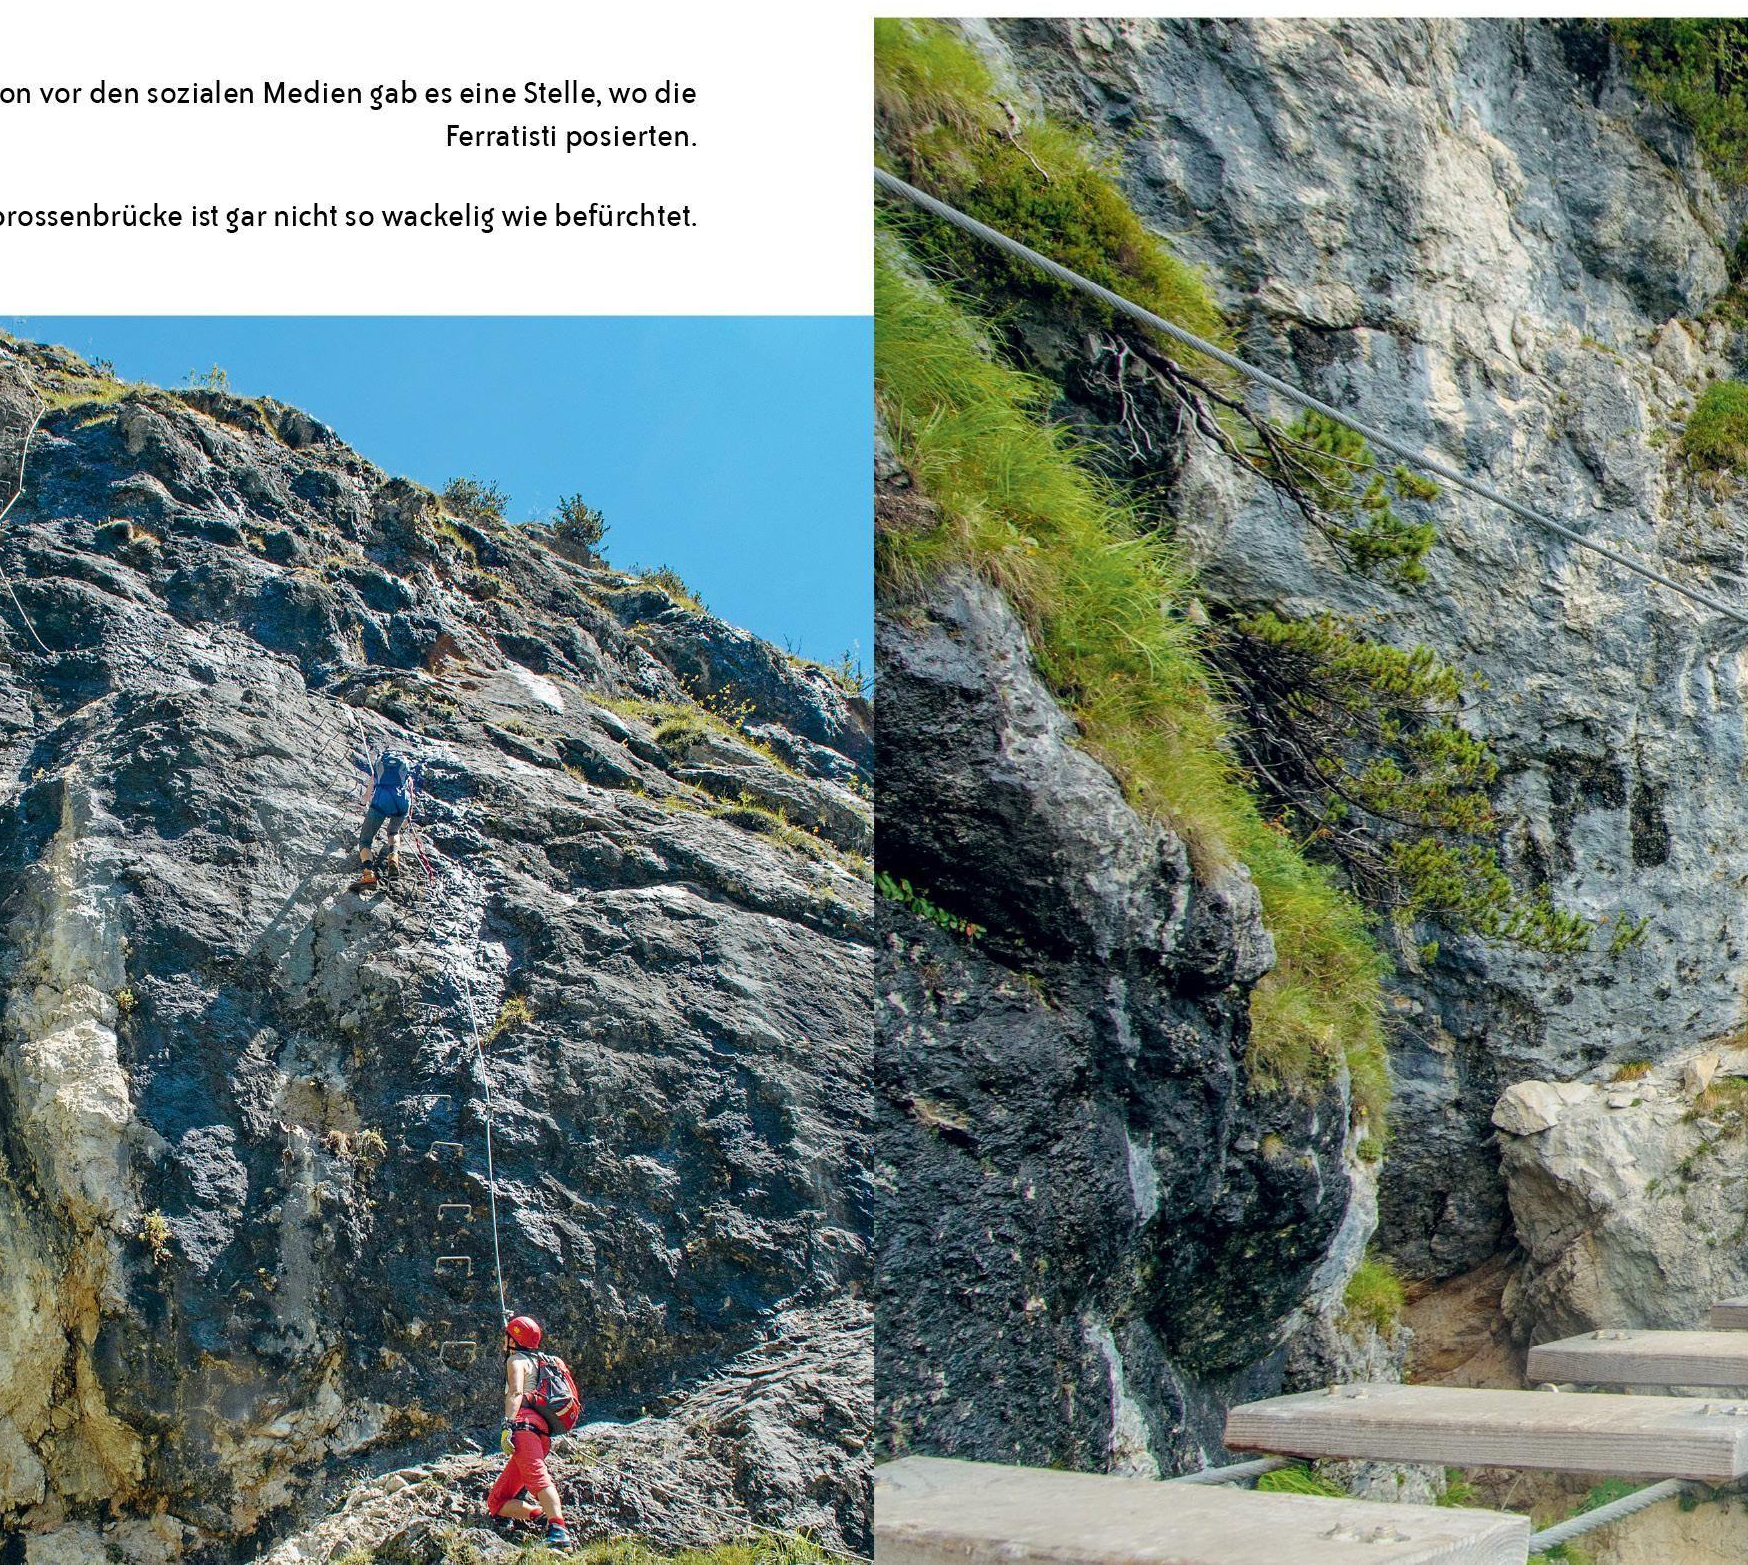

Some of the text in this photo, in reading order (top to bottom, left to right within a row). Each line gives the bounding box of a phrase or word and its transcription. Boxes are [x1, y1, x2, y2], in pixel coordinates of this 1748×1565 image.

[40, 88, 82, 103] vor
[90, 80, 138, 103] den
[148, 80, 253, 103] sozialen
[265, 80, 361, 103] Medien
[370, 80, 416, 110] gab
[426, 88, 451, 103] es
[460, 83, 516, 103] eine
[524, 80, 601, 107] Stelle,
[609, 88, 647, 103] wo
[656, 80, 696, 103] die
[448, 125, 696, 153] Ferratisti posierten.
[193, 206, 218, 226] ist
[226, 208, 267, 233] gar
[275, 203, 337, 226] nicht
[346, 211, 374, 226] so
[382, 203, 494, 233] wackelig
[502, 206, 547, 226] wie
[556, 203, 696, 226] befürchtet.
